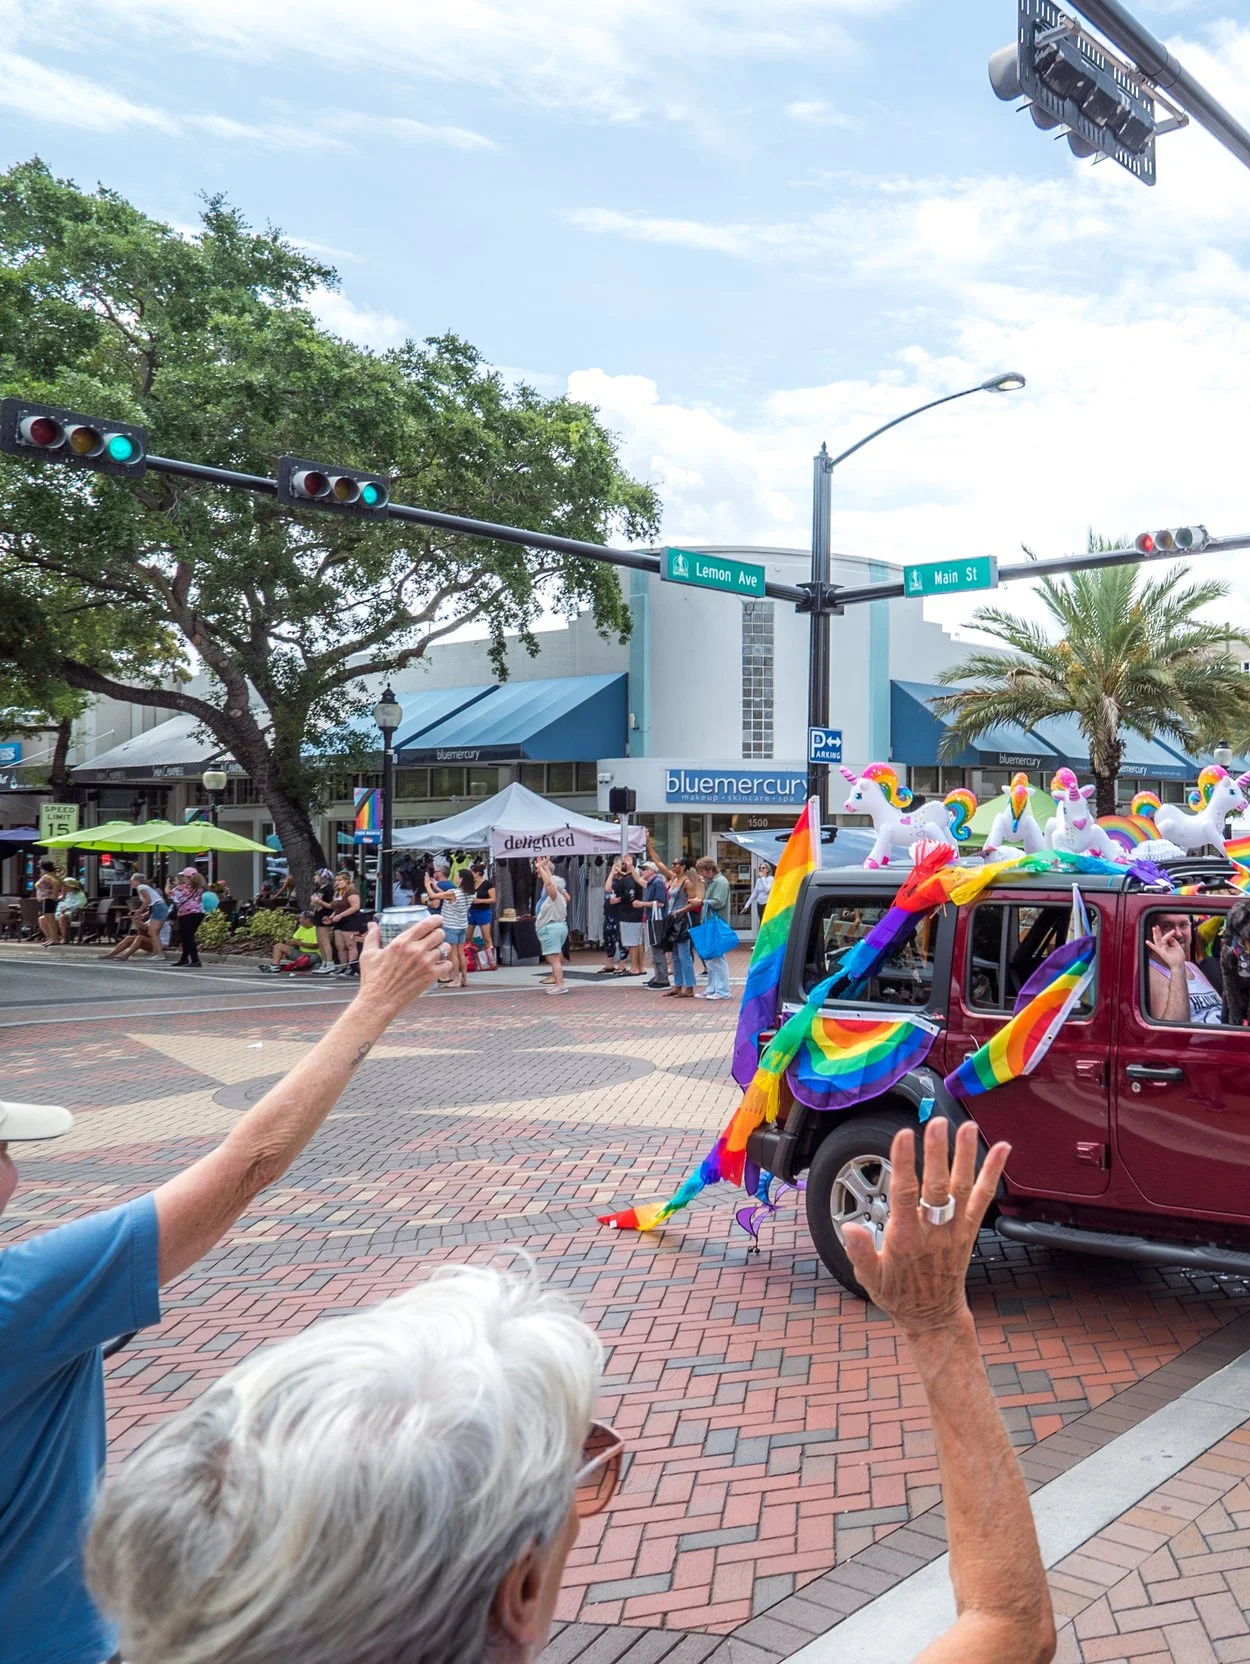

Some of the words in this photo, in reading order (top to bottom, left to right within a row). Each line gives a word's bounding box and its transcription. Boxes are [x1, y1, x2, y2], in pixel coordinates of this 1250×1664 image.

[696, 562, 731, 582] Lemon
[738, 571, 757, 587] Ave
[934, 569, 958, 585] Main
[966, 566, 977, 582] St
[437, 749, 480, 760] bluemercury
[999, 753, 1042, 768] bluemercury
[682, 794, 718, 802] makeup
[728, 794, 769, 802] skincare
[779, 795, 794, 803] spa
[44, 805, 75, 813] SPEED
[48, 823, 70, 837] 15
[748, 818, 768, 828] 1500
[504, 833, 575, 851] delighted
